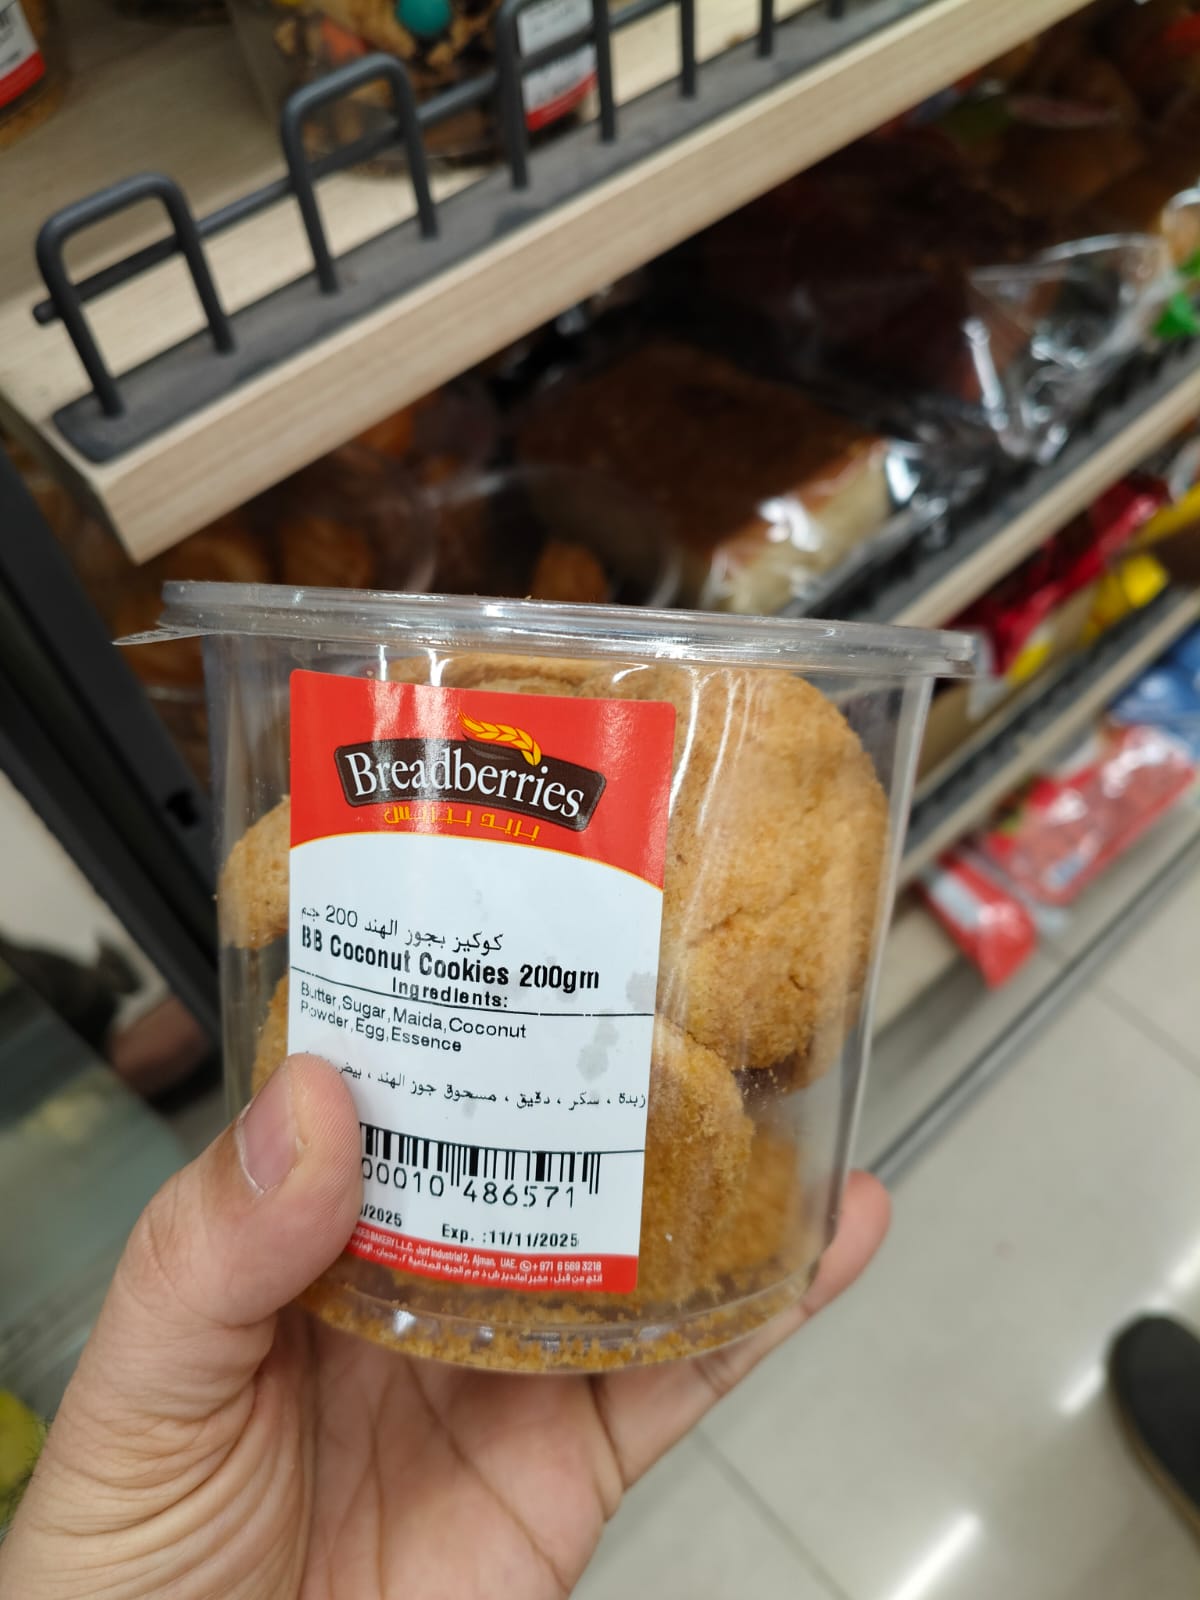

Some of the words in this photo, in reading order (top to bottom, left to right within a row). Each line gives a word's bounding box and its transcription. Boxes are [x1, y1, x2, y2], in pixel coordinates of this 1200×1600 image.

[344, 747, 585, 819] Breadberries
[325, 904, 358, 928] 200
[364, 919, 398, 940] الهند
[404, 929, 446, 948] بجوز
[452, 931, 504, 956] كوكيز
[301, 924, 323, 952] BB
[330, 934, 411, 973] Coconut
[419, 951, 509, 986] Cookies
[519, 963, 600, 994] 200gm
[392, 977, 508, 1008] Ingredients:
[377, 1072, 406, 1089] الهند
[411, 1080, 437, 1096] جوز
[443, 1084, 497, 1102] مسحوق
[516, 1091, 551, 1109] دقيق
[569, 1092, 600, 1110] سكر
[463, 1179, 574, 1209] 486571
[359, 1202, 403, 1228] /2025
